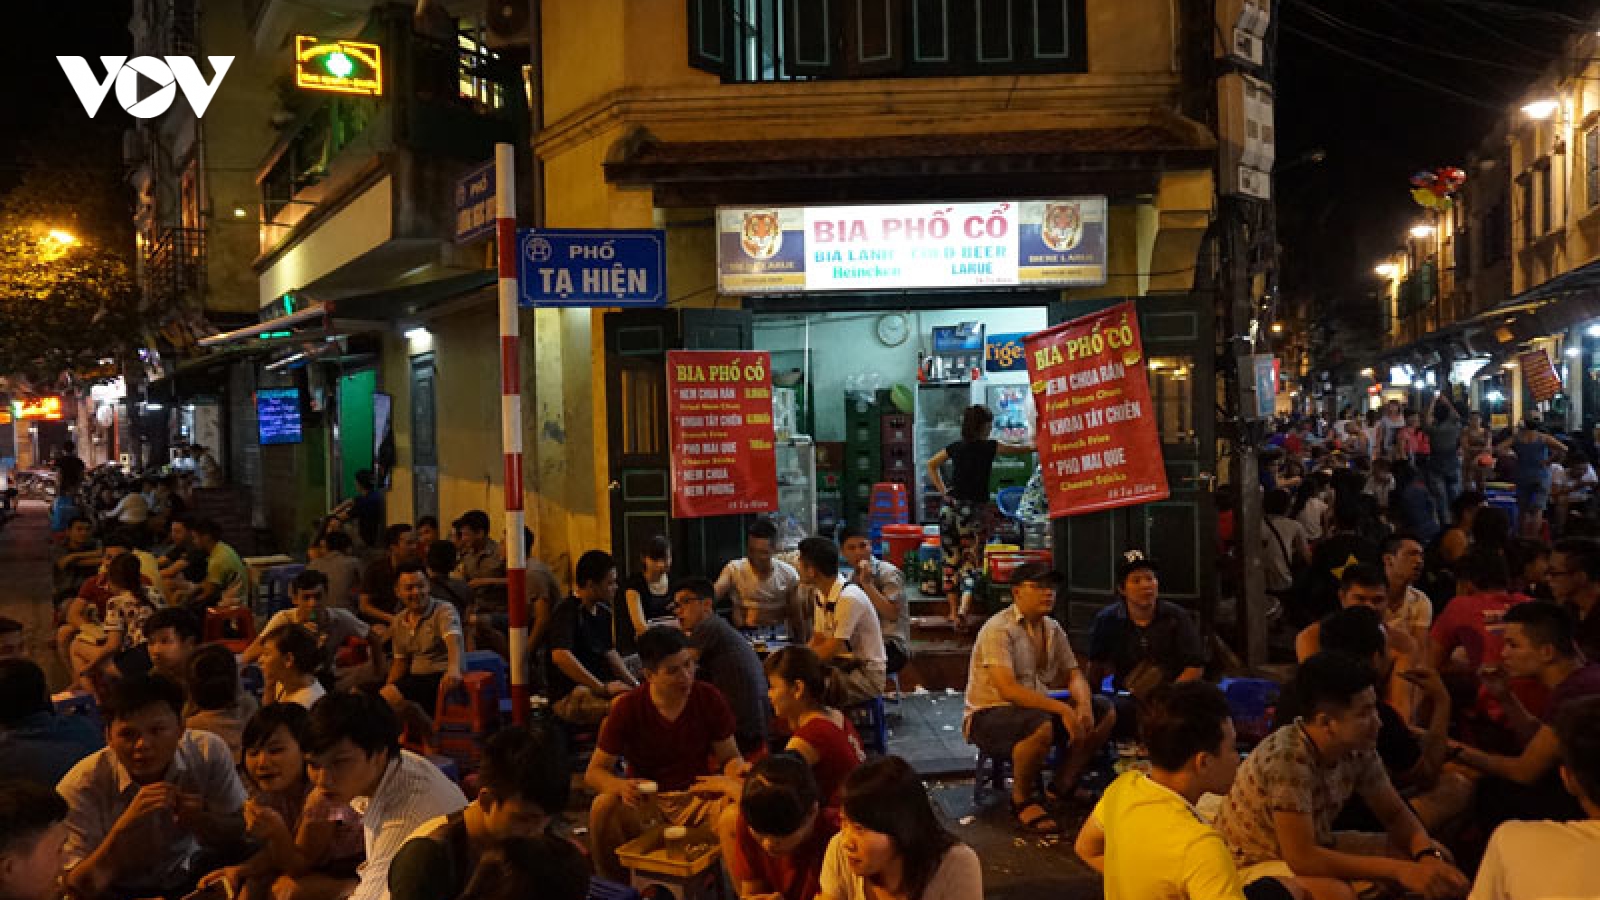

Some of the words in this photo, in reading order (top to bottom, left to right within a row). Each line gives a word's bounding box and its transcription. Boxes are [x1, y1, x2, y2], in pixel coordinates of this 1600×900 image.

[814, 219, 868, 242] BIA
[882, 206, 954, 241] PHỐ
[963, 202, 1011, 239] CỔ
[570, 240, 616, 259] PHỐ
[538, 268, 574, 298] TẠ
[582, 262, 647, 298] HIỆN
[951, 262, 993, 275] LARUE
[1034, 344, 1065, 371] BIA
[1066, 321, 1104, 361] PHỐ
[1104, 312, 1133, 349] CỔ
[676, 364, 705, 382] BIA
[708, 358, 741, 382] PHỐ
[1069, 367, 1100, 391] CHUA
[1049, 413, 1084, 436] KHOAI
[1081, 452, 1103, 472] MAI
[1103, 447, 1127, 468] QUE
